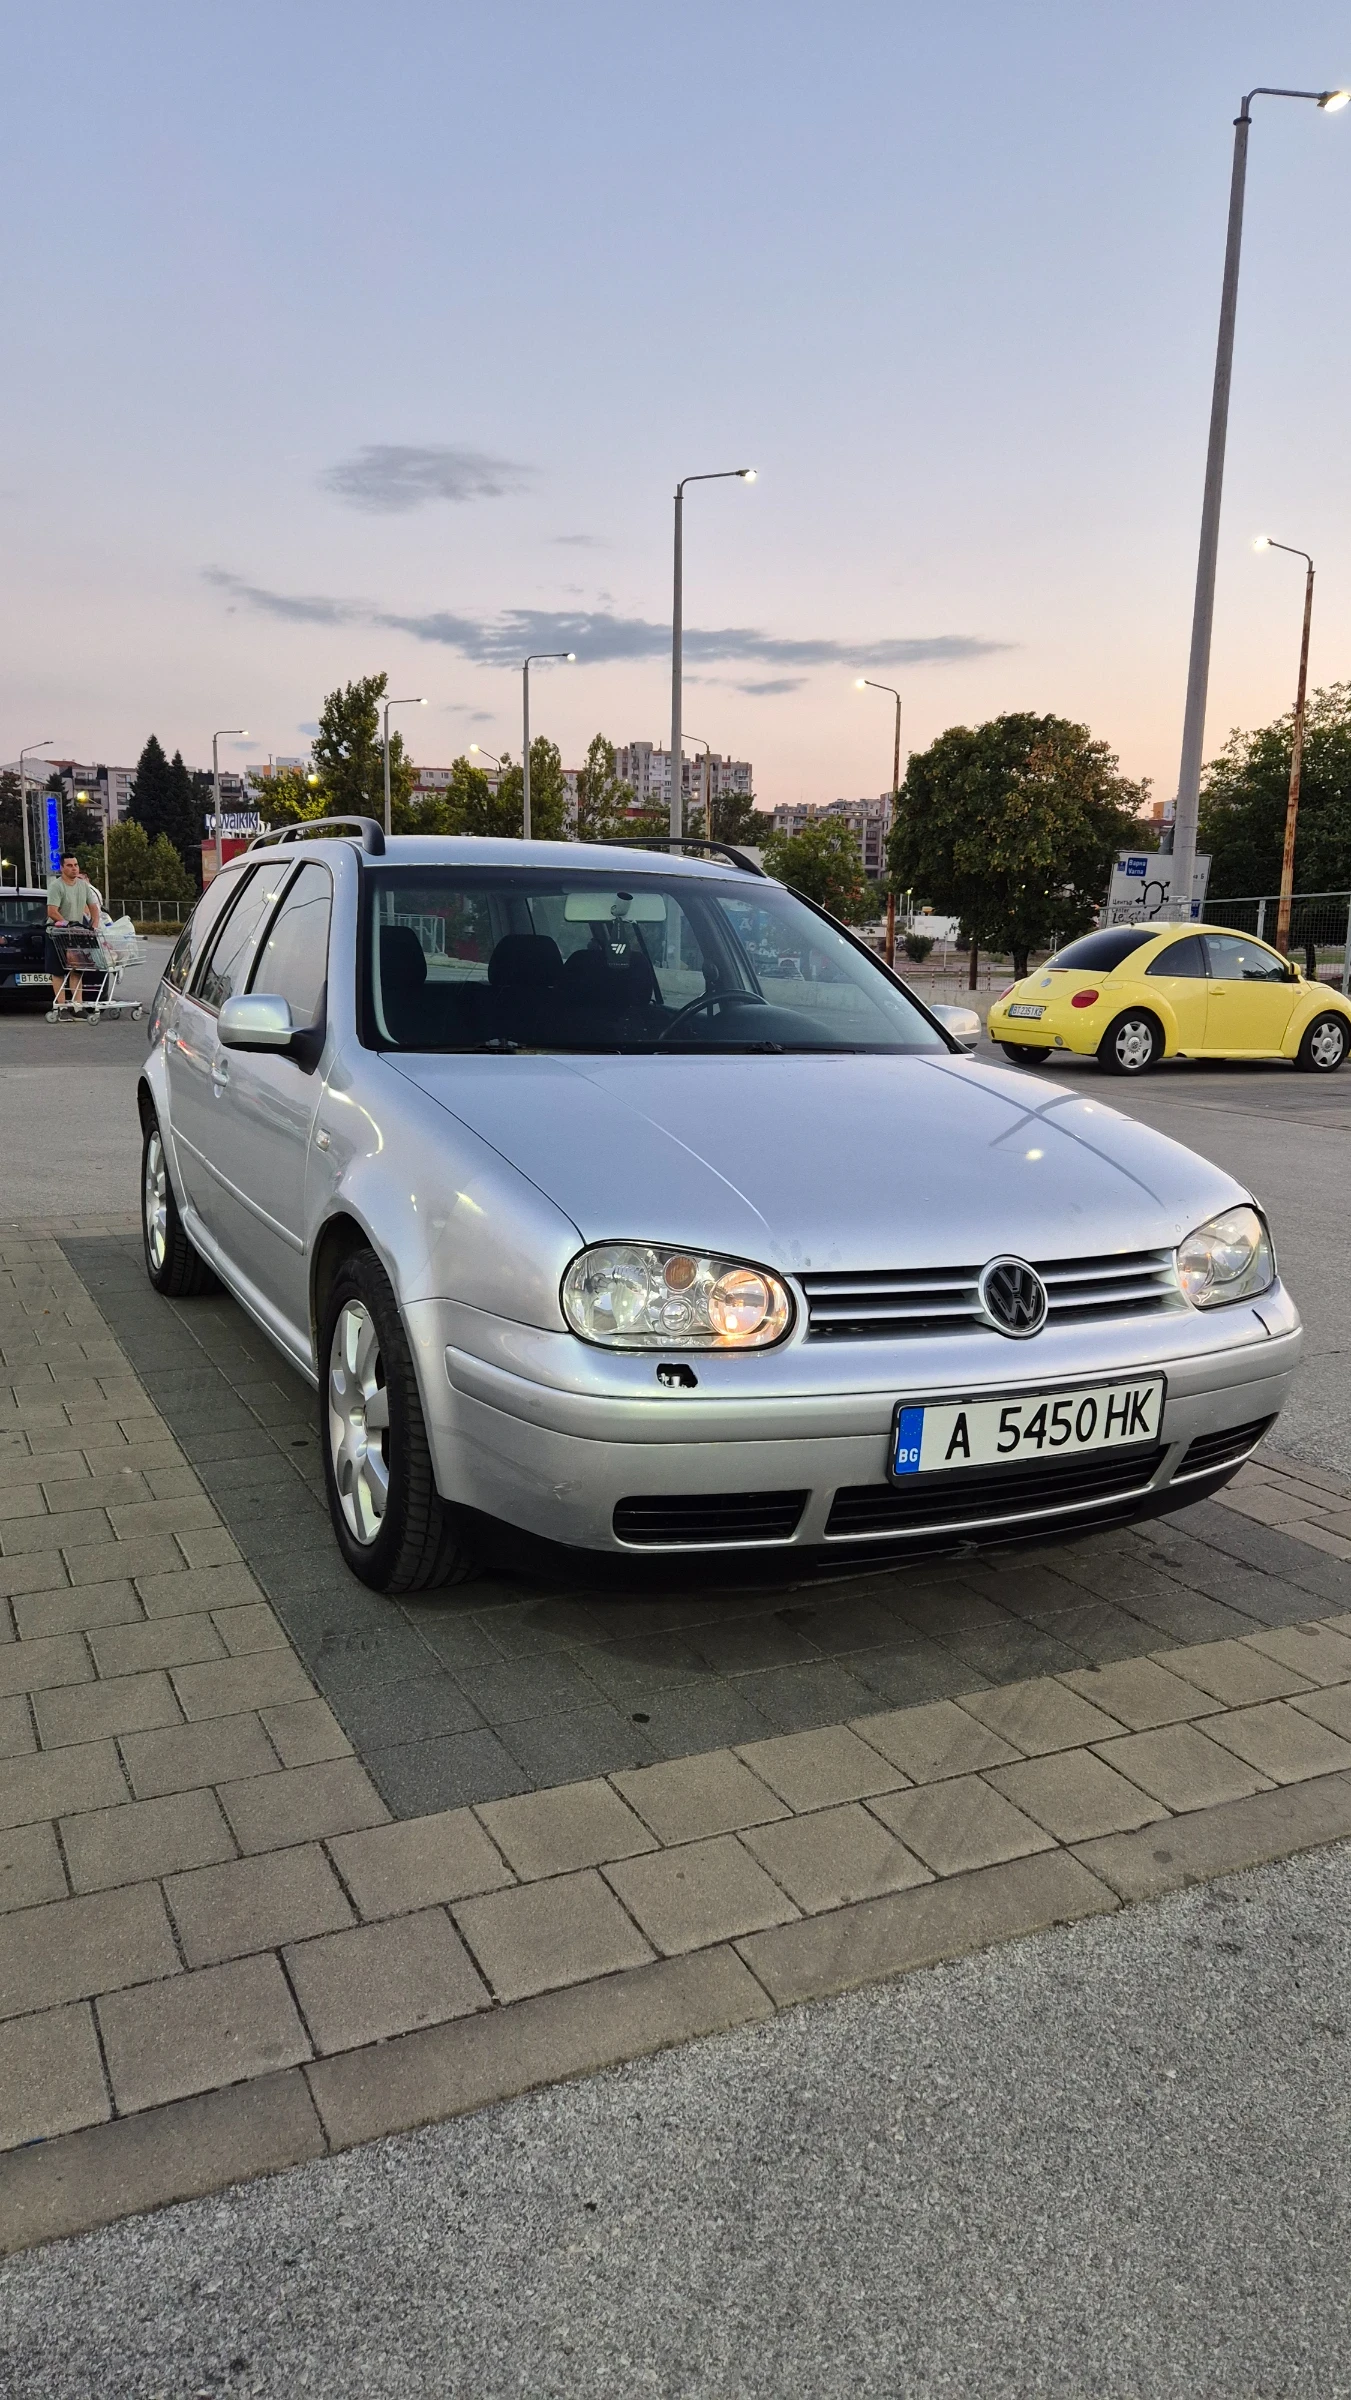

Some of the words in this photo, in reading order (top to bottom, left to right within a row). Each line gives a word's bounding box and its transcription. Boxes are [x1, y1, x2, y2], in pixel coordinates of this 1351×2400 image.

[944, 1412, 971, 1460] A
[997, 1397, 1098, 1453] 5450
[1103, 1388, 1155, 1439] HK
[898, 1448, 918, 1464] BG
